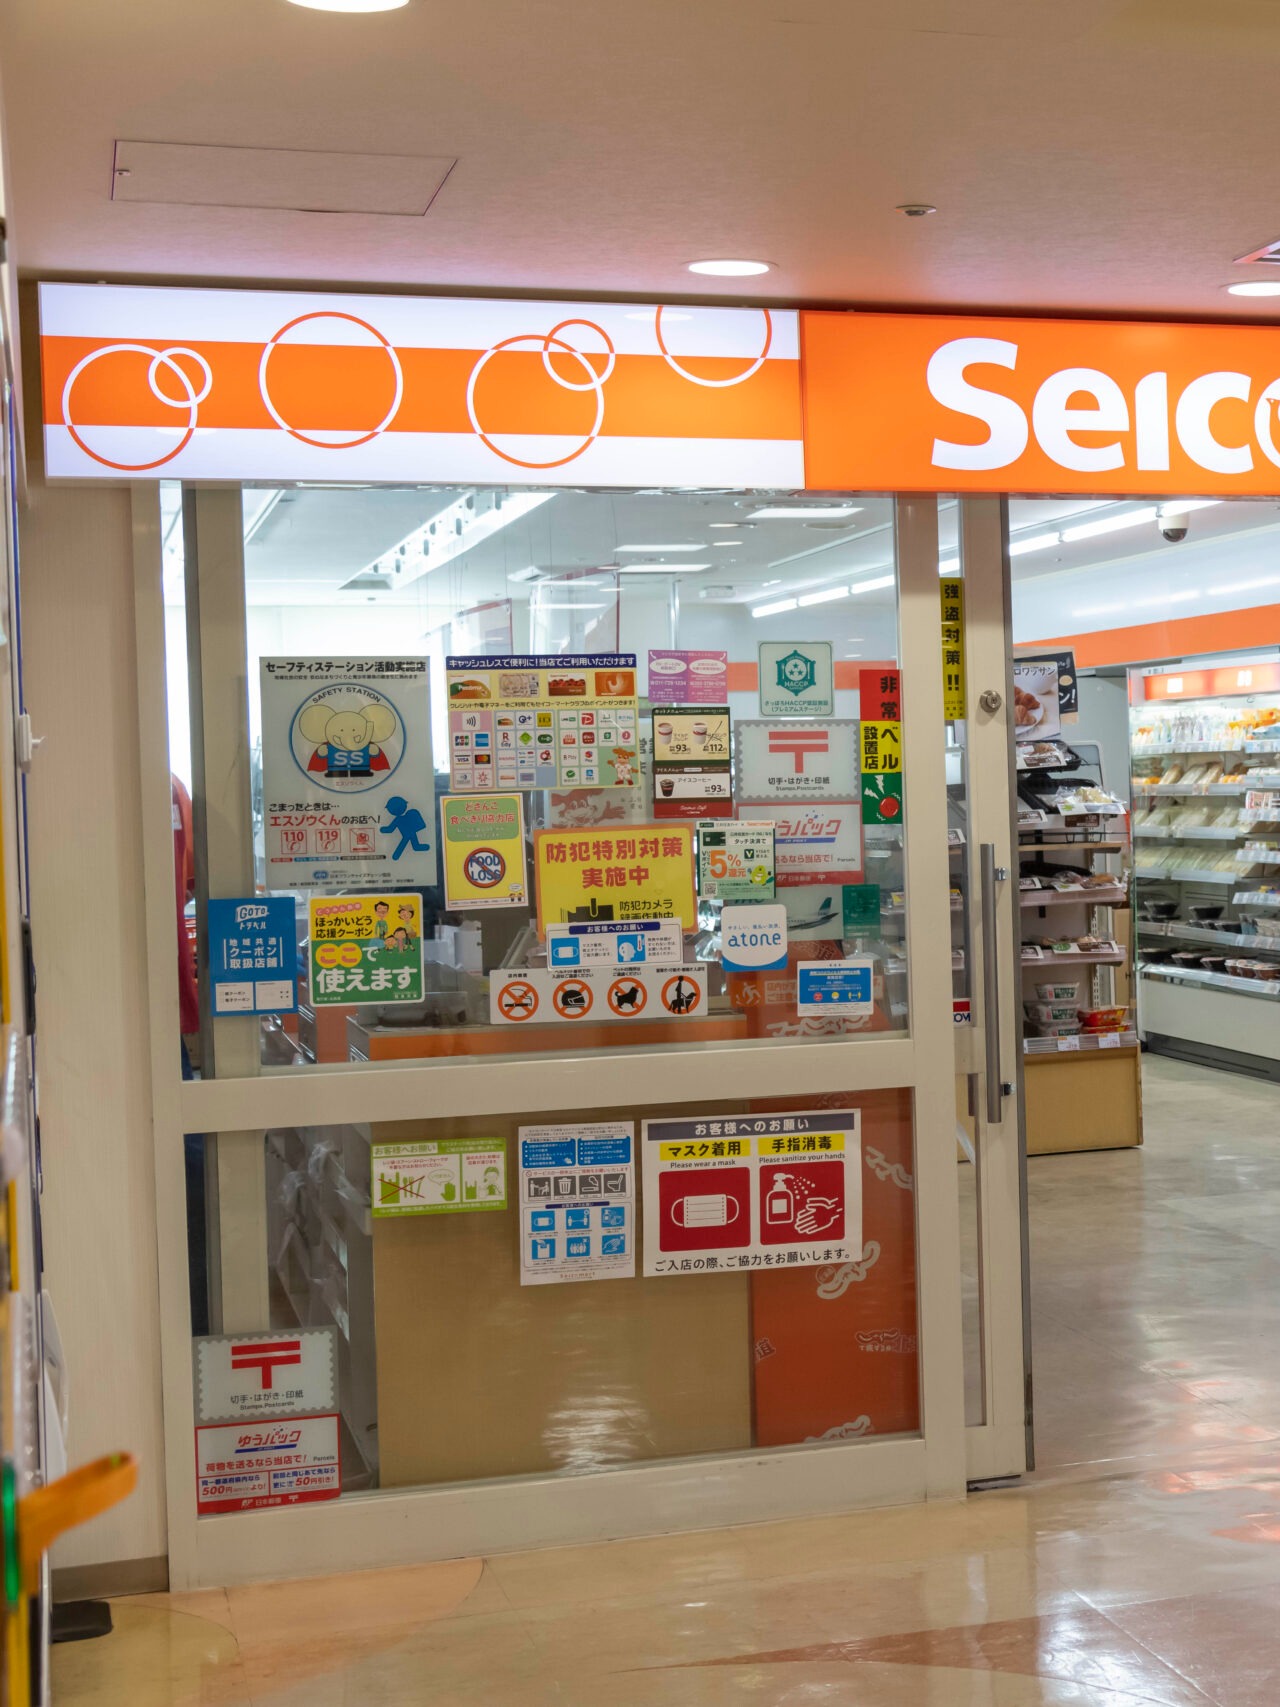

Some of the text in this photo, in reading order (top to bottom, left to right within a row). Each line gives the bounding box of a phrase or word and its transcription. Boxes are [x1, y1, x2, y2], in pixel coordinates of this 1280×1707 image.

[312, 687, 381, 704] SAFETY STATION
[334, 752, 364, 765] SS
[768, 777, 830, 785] 切手・はがき・印紙
[465, 802, 498, 812] どさんこ
[270, 815, 381, 827] エスゾウくんのお店へ!
[776, 818, 842, 836] うパック
[283, 831, 304, 842] 110
[318, 831, 338, 841] 119
[546, 837, 683, 864] 防犯特別対策
[470, 855, 500, 867] FOOD
[471, 870, 500, 881] LOSS
[582, 866, 649, 889] 実施中
[620, 899, 673, 911] 防犯カメラ
[315, 916, 372, 927] ほっかいどう
[587, 924, 643, 932] お客様へのお願い
[316, 928, 372, 938] 応援クーポン
[728, 932, 781, 947] atone
[229, 938, 276, 946] 地域共通
[230, 947, 277, 957] クーポン
[320, 946, 377, 962] ここで
[229, 958, 278, 969] 取扱店舗
[316, 967, 417, 994] 使えます
[695, 1119, 809, 1135] お客様へのお願い
[669, 1142, 741, 1157] マスク着用
[772, 1137, 832, 1152] 手指消毒
[656, 1248, 850, 1272] ご入店の際、ご協力をお願いします。
[230, 1390, 304, 1404] 切手・はがき・印紙
[238, 1430, 302, 1447] ゆうパック
[206, 1454, 308, 1472] 荷物を送るなら当店で!
